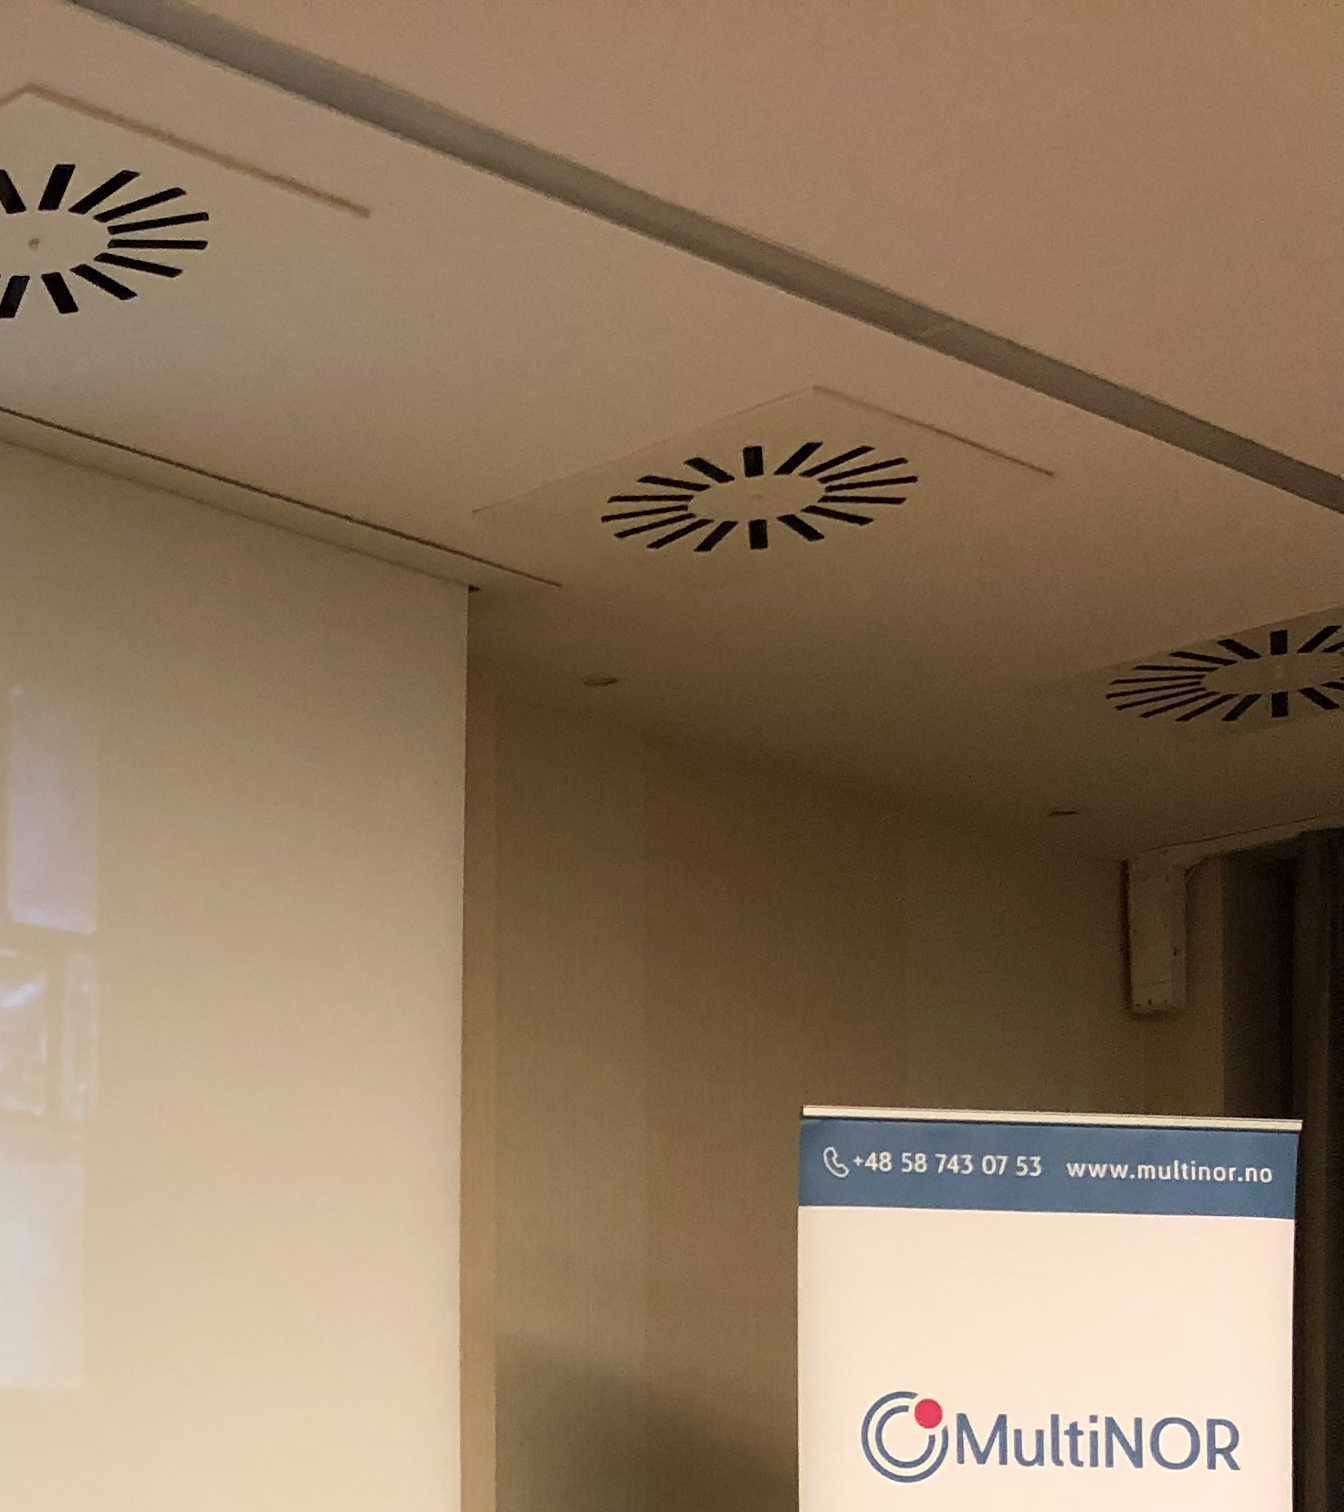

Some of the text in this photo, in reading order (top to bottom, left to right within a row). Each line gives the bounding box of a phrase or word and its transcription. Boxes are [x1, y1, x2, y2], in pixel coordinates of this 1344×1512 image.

[853, 1152, 1042, 1176] +48 58 743 07 53
[1066, 1159, 1273, 1184] www.multinor.no
[955, 1412, 1241, 1471] MultiNOR
